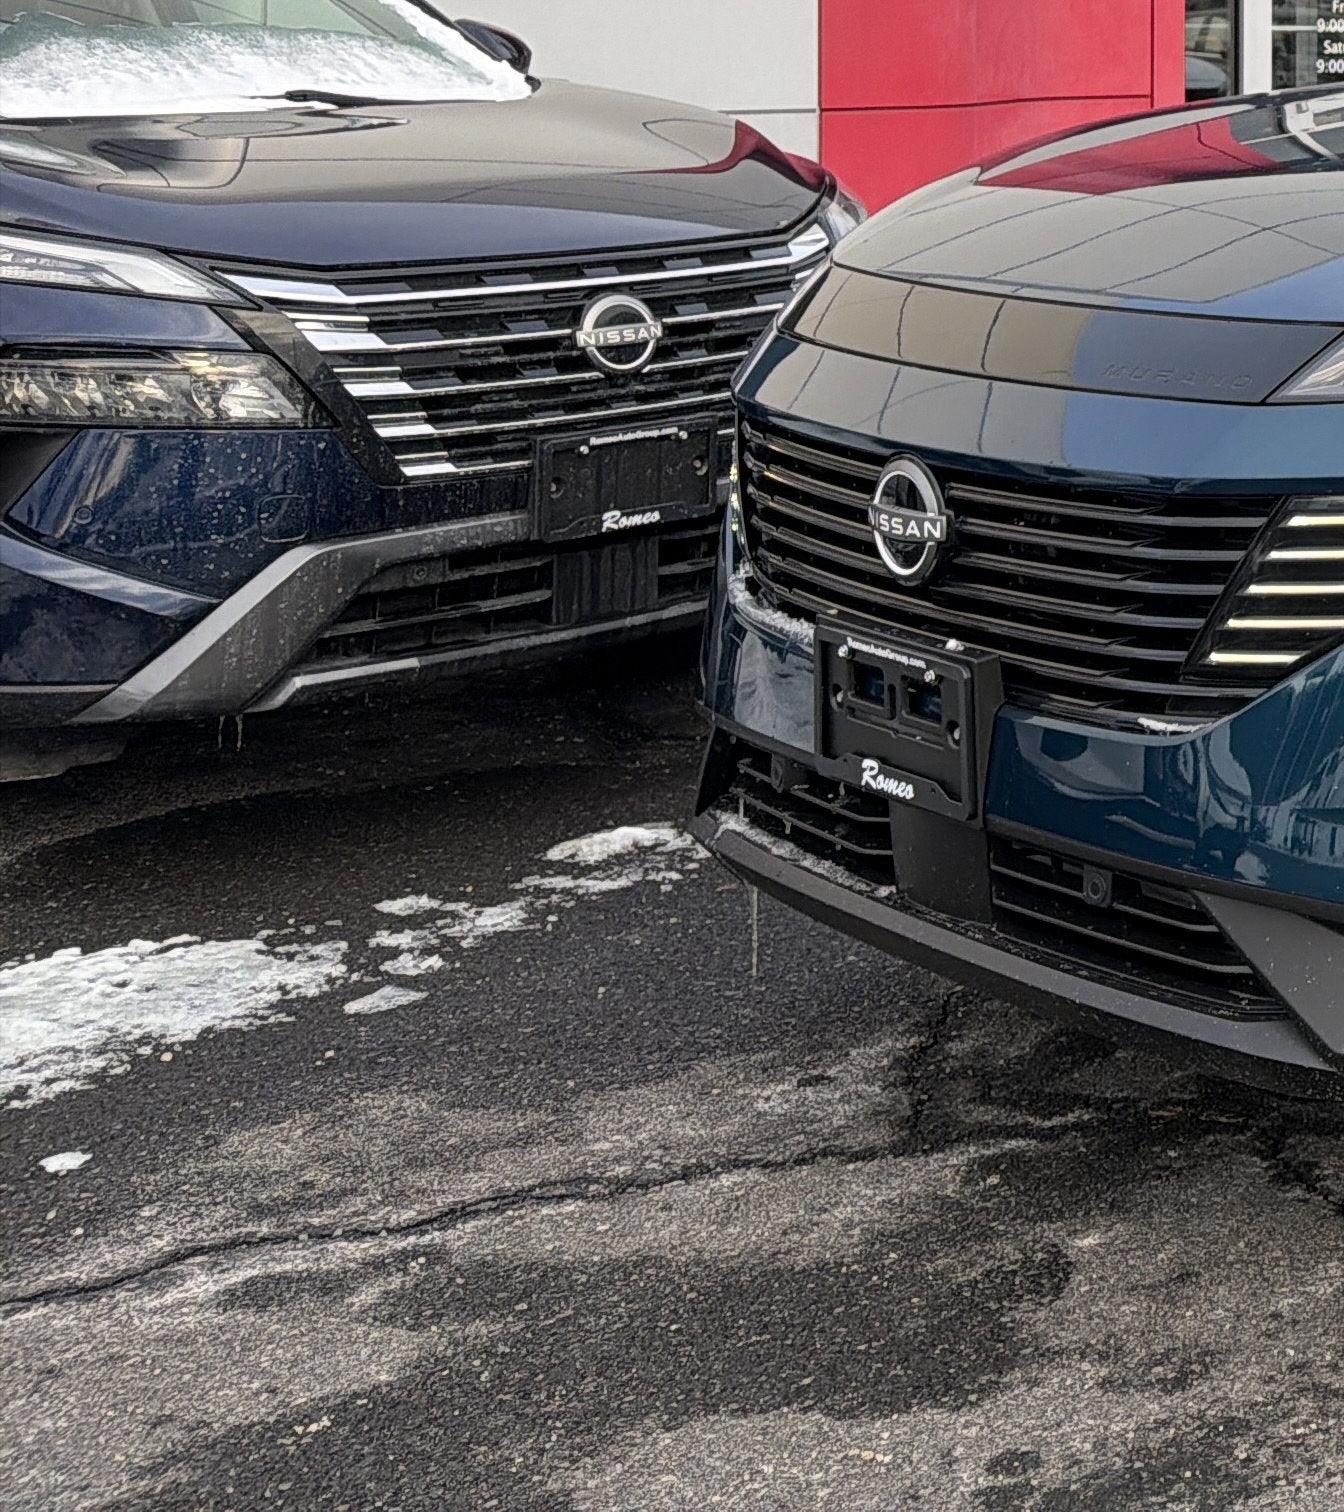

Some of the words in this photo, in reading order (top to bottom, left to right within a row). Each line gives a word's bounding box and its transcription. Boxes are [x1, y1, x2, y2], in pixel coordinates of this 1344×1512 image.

[1316, 19, 1344, 32] 9:00
[1316, 59, 1344, 73] 9:00
[579, 324, 662, 347] NISSAN
[1102, 363, 1254, 388] MURANO
[590, 427, 679, 446] RomeoAutoGroup.com
[601, 510, 661, 532] Romeo
[868, 506, 941, 539] NISSAN
[846, 636, 927, 669] RomeoAutoGroup.com
[860, 758, 915, 800] Romeo
